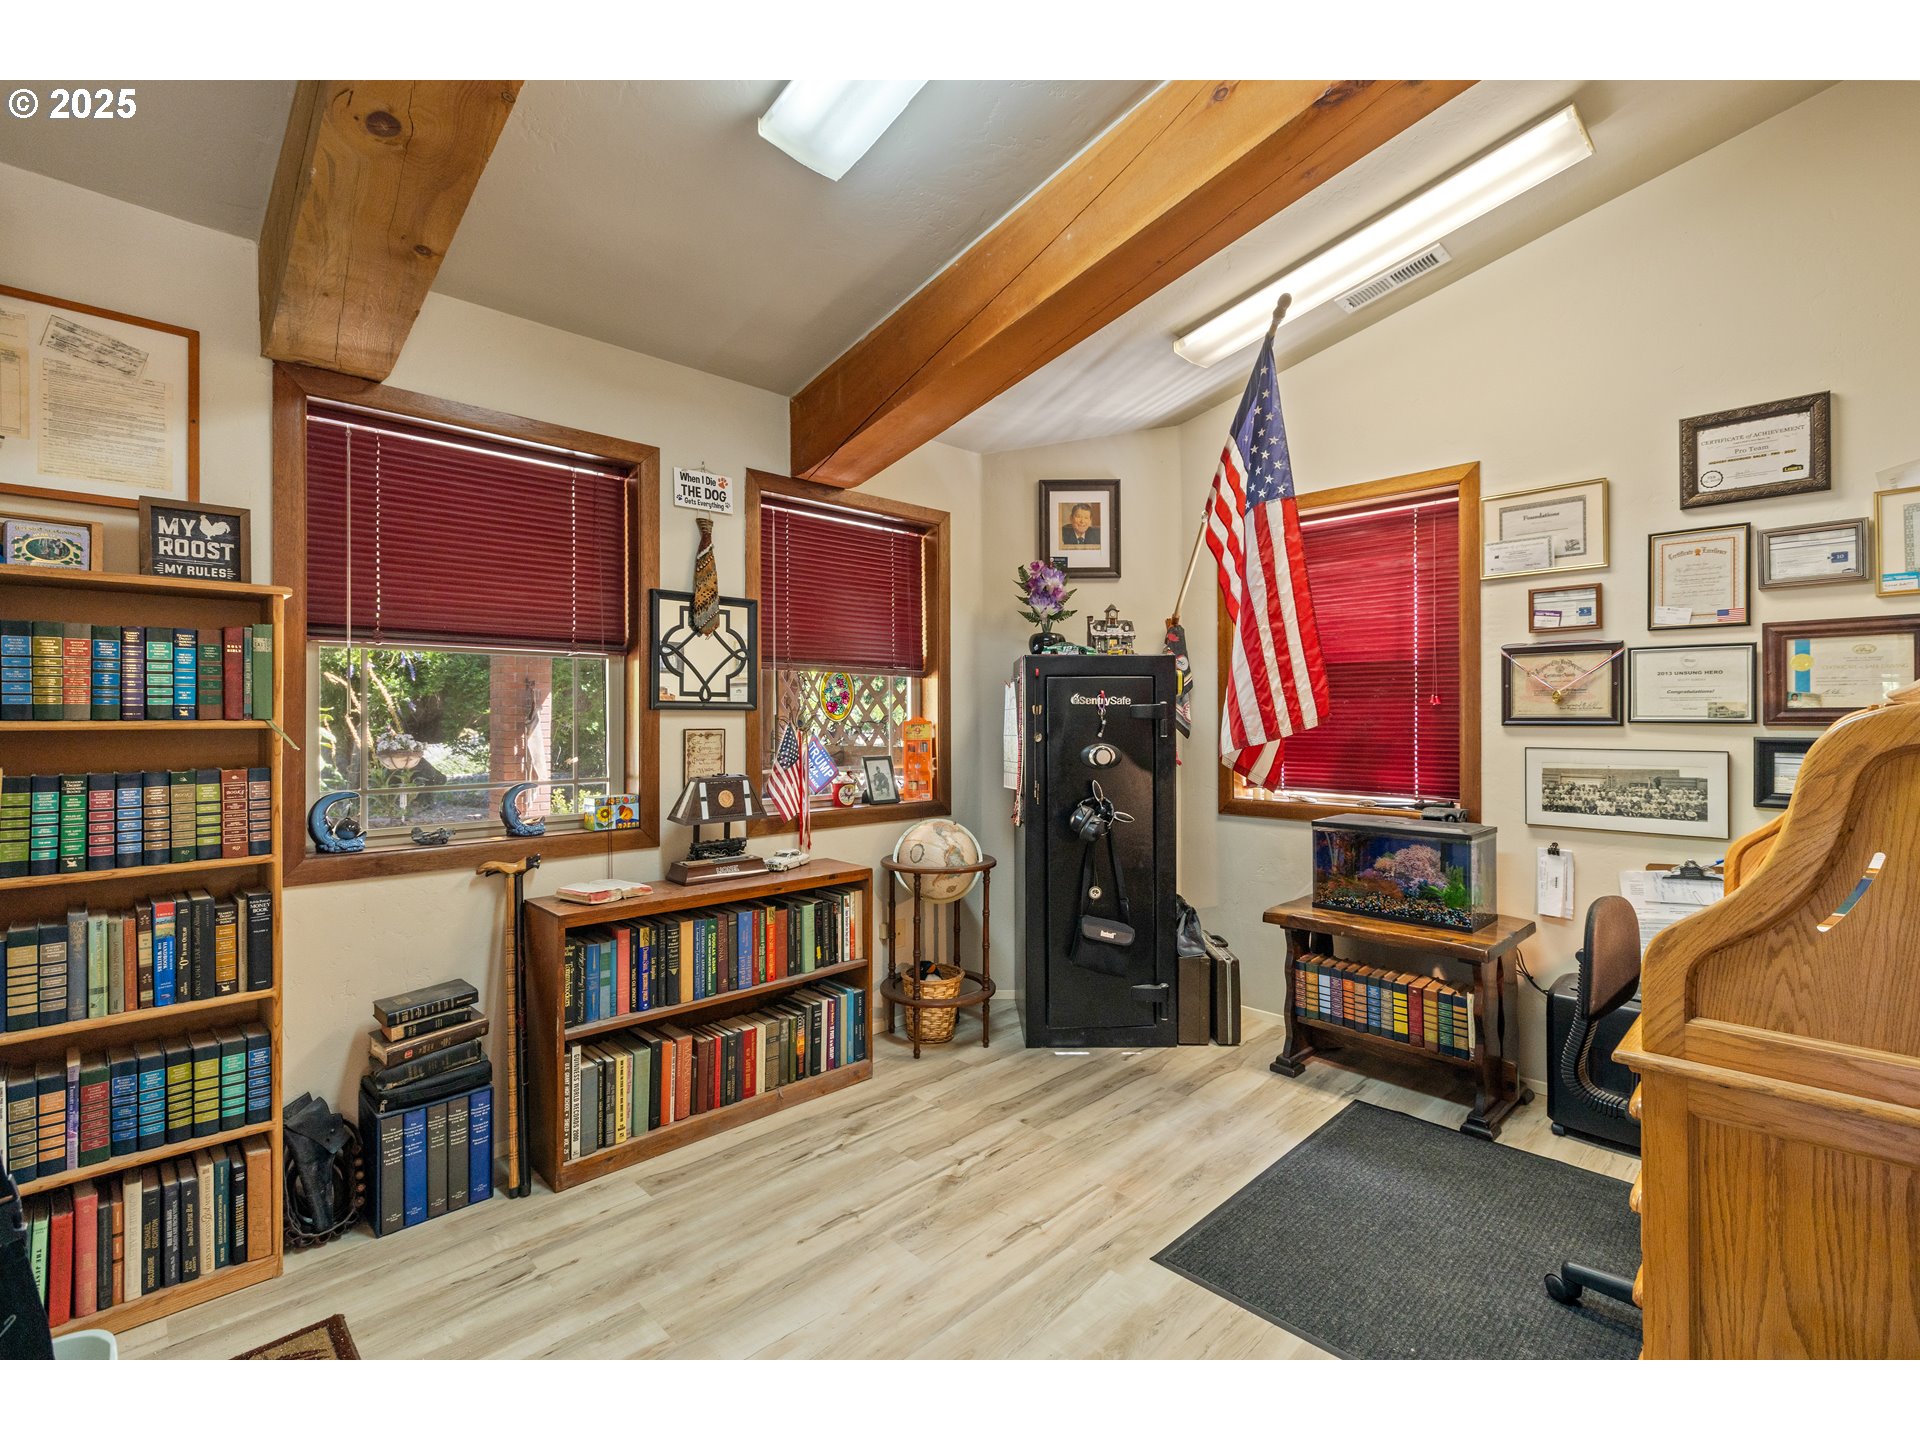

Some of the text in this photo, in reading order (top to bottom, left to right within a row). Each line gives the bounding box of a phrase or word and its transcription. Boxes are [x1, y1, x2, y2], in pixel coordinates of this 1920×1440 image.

[1701, 436, 1744, 446] CERTIFICATE
[1753, 425, 1805, 438] ACHIEVEMENT
[680, 472, 700, 483] When
[706, 476, 716, 486] Die
[681, 484, 726, 502] THE DOG
[685, 497, 724, 511] Gets Everything
[158, 516, 197, 537] MY
[1523, 512, 1560, 520] Foundations
[158, 537, 235, 561] ROOST
[164, 563, 226, 578] MY RULES
[809, 741, 834, 777] TRUMP
[144, 1222, 152, 1249] MICHAEL
[147, 1256, 155, 1288] DISCLOSURE
